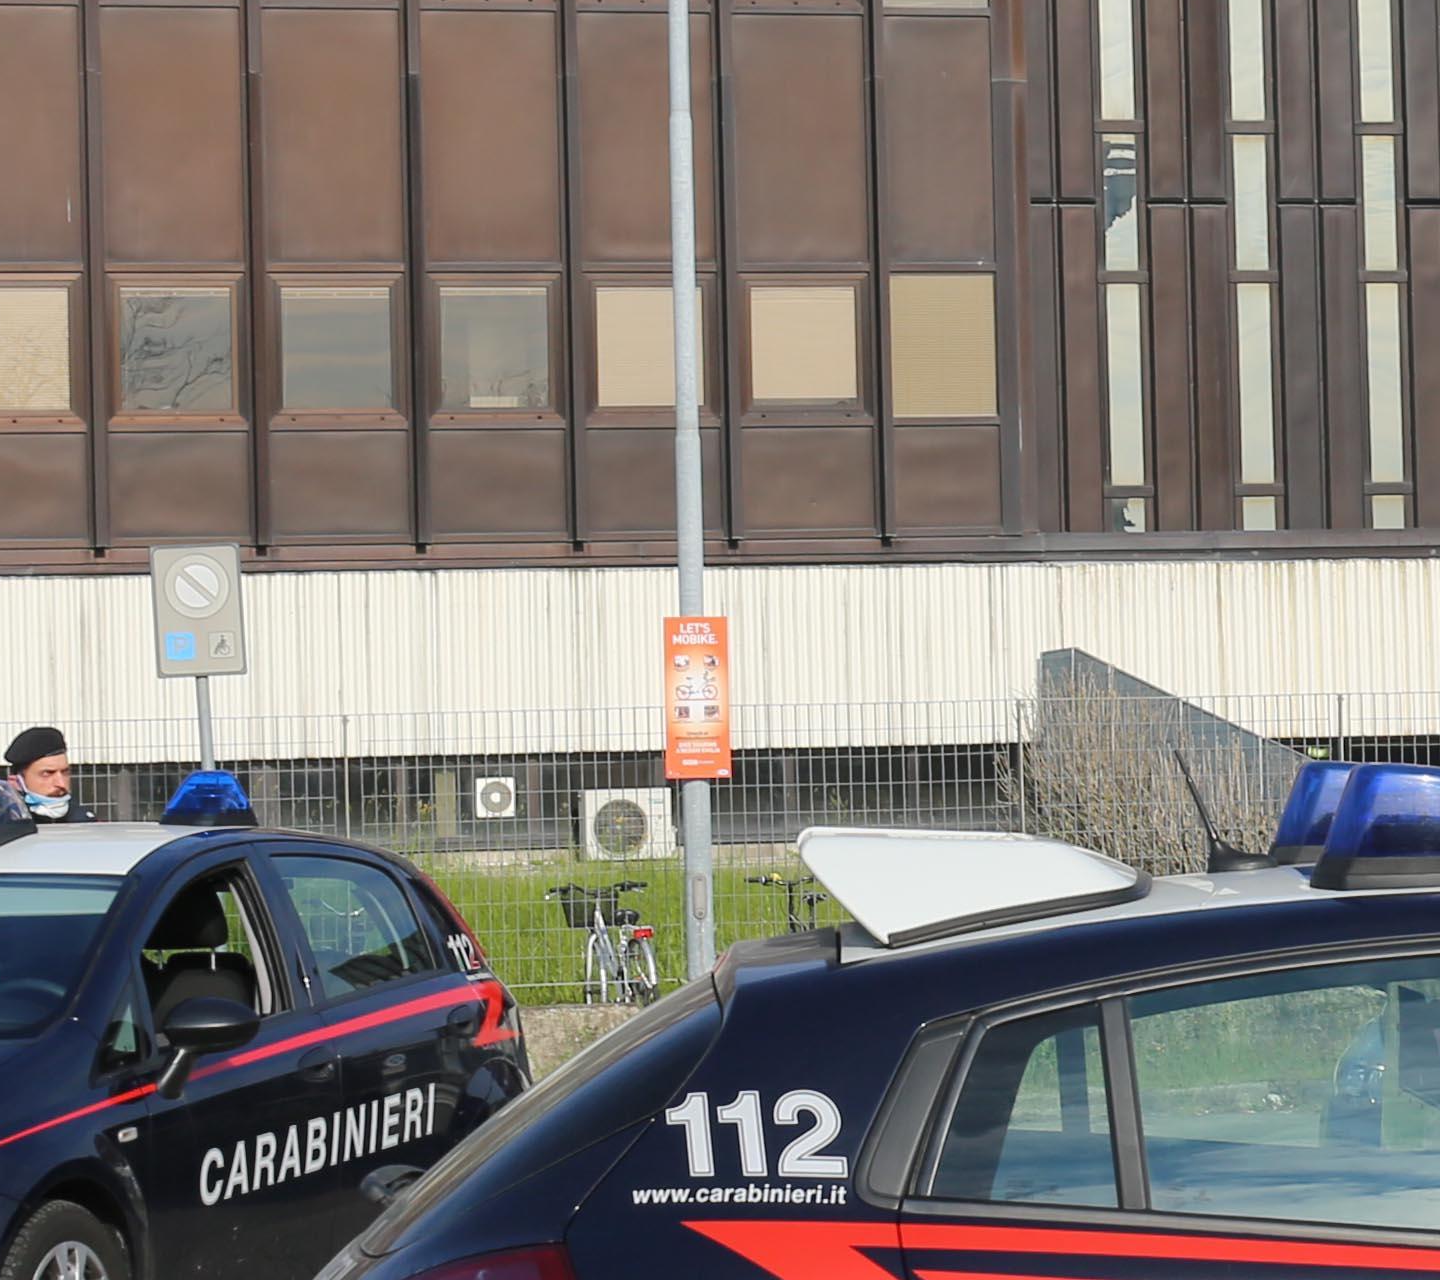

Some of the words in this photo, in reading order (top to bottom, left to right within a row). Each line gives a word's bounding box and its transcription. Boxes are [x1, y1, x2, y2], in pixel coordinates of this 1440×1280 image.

[679, 622, 710, 635] LET'S
[447, 933, 481, 972] 112
[199, 1082, 437, 1207] CARABINIERI
[665, 1089, 849, 1179] 112
[632, 1183, 848, 1205] www.carabinieri.it
